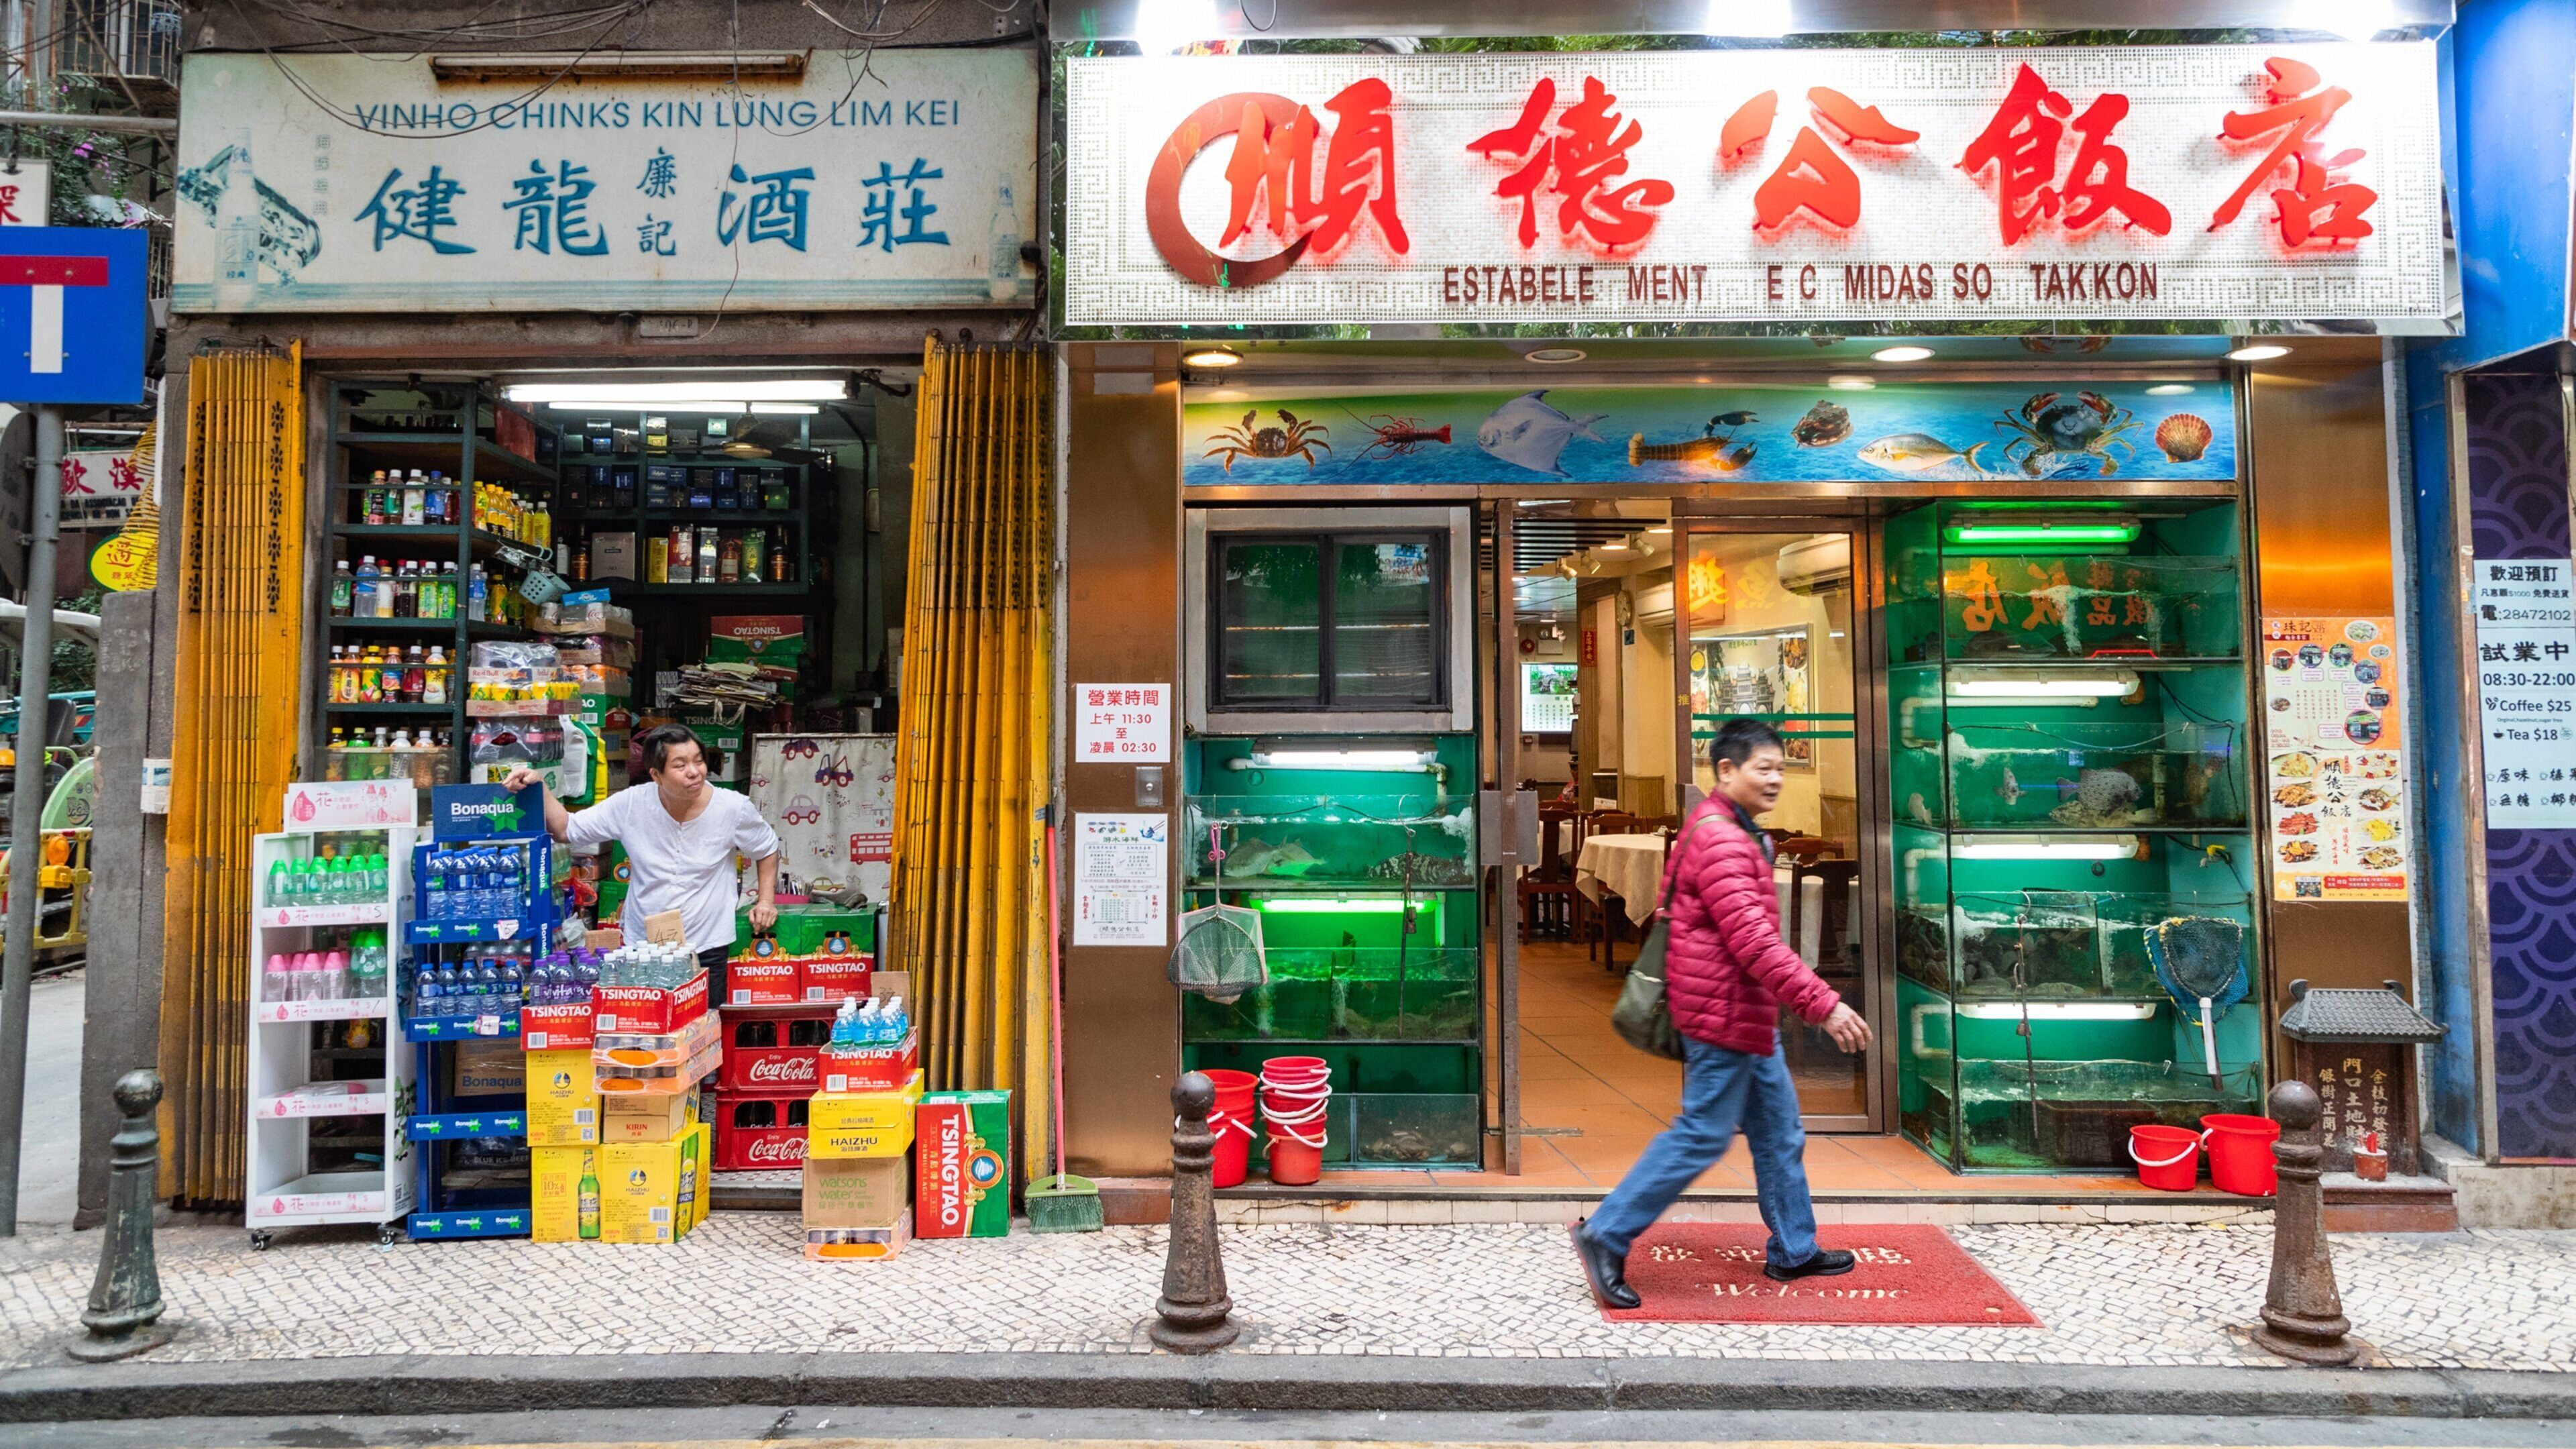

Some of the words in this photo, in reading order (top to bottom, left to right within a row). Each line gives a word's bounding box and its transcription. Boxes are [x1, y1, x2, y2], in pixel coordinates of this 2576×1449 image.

[356, 103, 476, 130] VINHO
[490, 101, 630, 129] CHINKS
[643, 101, 702, 127] KIN
[716, 101, 818, 127] LUNG
[832, 100, 891, 126] LIM
[906, 100, 959, 125] KEI
[1444, 265, 1594, 304] ESTABELE
[1627, 265, 1707, 302] MENT
[1767, 264, 1782, 301] E
[1800, 264, 1818, 300] C
[1845, 263, 1933, 301] MIDAS
[1953, 262, 1992, 299] SO
[2030, 263, 2158, 300] TAKKON
[2490, 565, 2558, 582] 歡迎預訂
[2481, 604, 2571, 621] 電:28472102
[2479, 641, 2569, 663] 試業中
[2483, 673, 2575, 686] 08:30-22:00
[1088, 690, 1159, 706] 營業時間
[1677, 694, 1689, 706] 推
[2500, 700, 2544, 711] Coffee
[2547, 699, 2572, 713] $25
[1090, 713, 1115, 724] 上午
[1122, 714, 1152, 724] 11:30
[1116, 728, 1127, 739] 至
[2506, 729, 2530, 740] Tea
[2534, 728, 2558, 742] $18
[1089, 741, 1115, 753] 凌晨
[1122, 743, 1157, 753] 02:30
[2497, 768, 2530, 783] 原味
[451, 802, 515, 816] Bonaqua
[735, 965, 793, 976] TSINGTAO
[808, 963, 865, 974] TSINGTAO
[600, 989, 661, 1001] TSINGTAO
[674, 977, 706, 1006] TSINGTAO
[529, 1006, 592, 1018] TSINGTAO
[749, 1057, 816, 1081] Coca-Cola
[463, 1075, 522, 1089] Bonaqua
[2319, 1068, 2337, 1148] 銀樹正開花
[625, 1123, 648, 1131] KIRIN
[831, 1137, 878, 1146] HAIZHU
[941, 1114, 959, 1226] TSINGTAO
[819, 1177, 867, 1188] watsons
[819, 1190, 853, 1199] water
